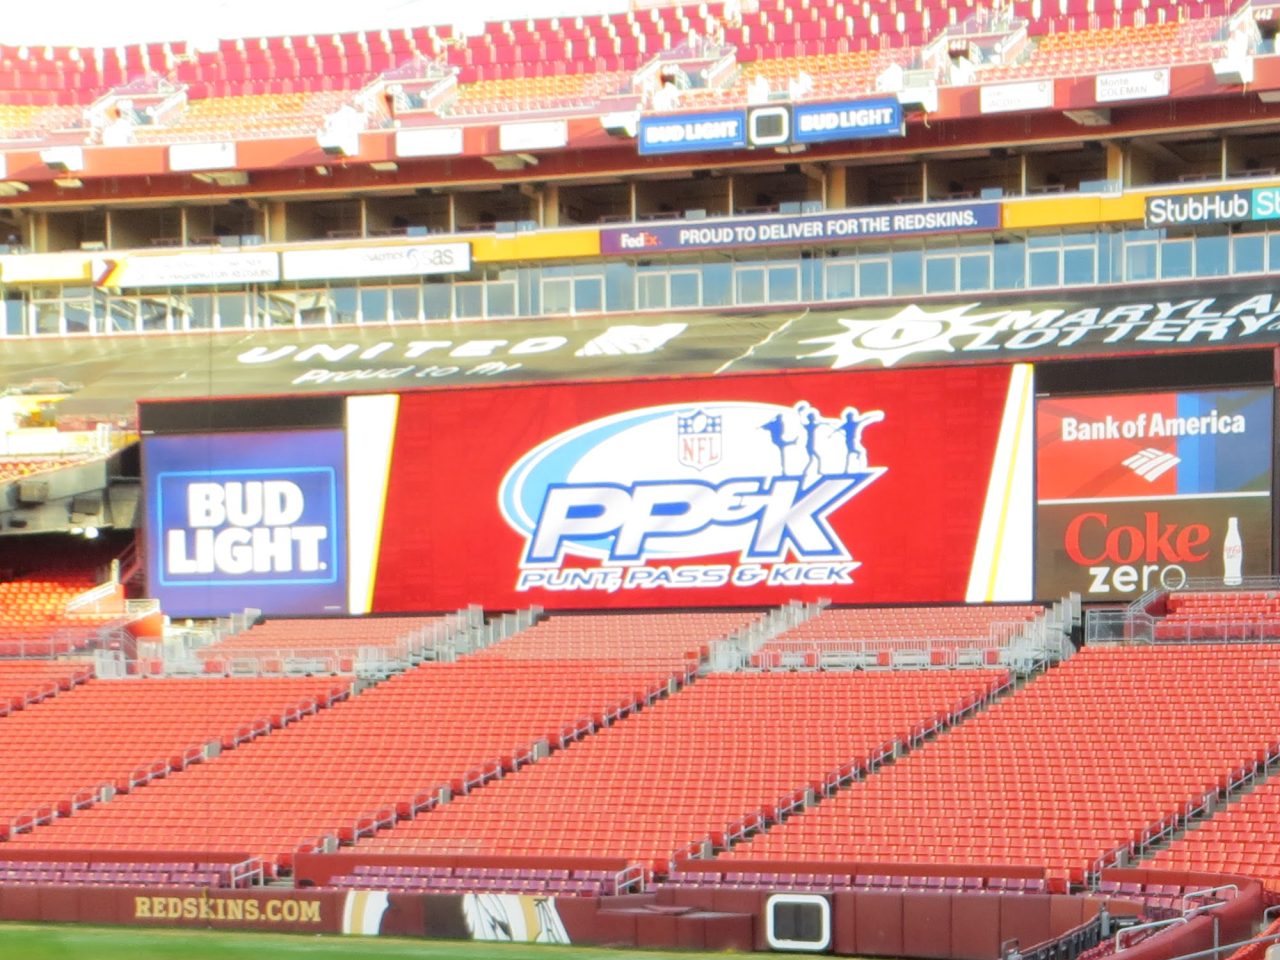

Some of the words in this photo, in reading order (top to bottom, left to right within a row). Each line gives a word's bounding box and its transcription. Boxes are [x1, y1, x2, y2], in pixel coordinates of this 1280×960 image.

[646, 125, 684, 144] BUD
[685, 120, 738, 141] LIGHT
[800, 112, 839, 132] BUD
[840, 108, 893, 128] LIGHT
[1149, 194, 1249, 223] StubHub
[620, 232, 662, 248] FedEx
[679, 227, 733, 245] PROUD
[735, 226, 756, 242] TO
[759, 220, 823, 240] DELIVER
[827, 219, 858, 236] FOR
[859, 215, 890, 232] THE
[236, 336, 568, 364] UNITED
[1061, 415, 1120, 441] Bank
[1122, 413, 1147, 437] of
[1148, 409, 1245, 437] America
[682, 436, 719, 465] NFL
[188, 480, 304, 528] BUD
[1064, 511, 1212, 567] Coke
[519, 571, 623, 591] PUNT,
[628, 568, 726, 584] PASS
[736, 566, 768, 583] &
[771, 564, 852, 582] KICK
[1088, 564, 1187, 593] zero
[134, 895, 322, 923] REDSKINS.COM
